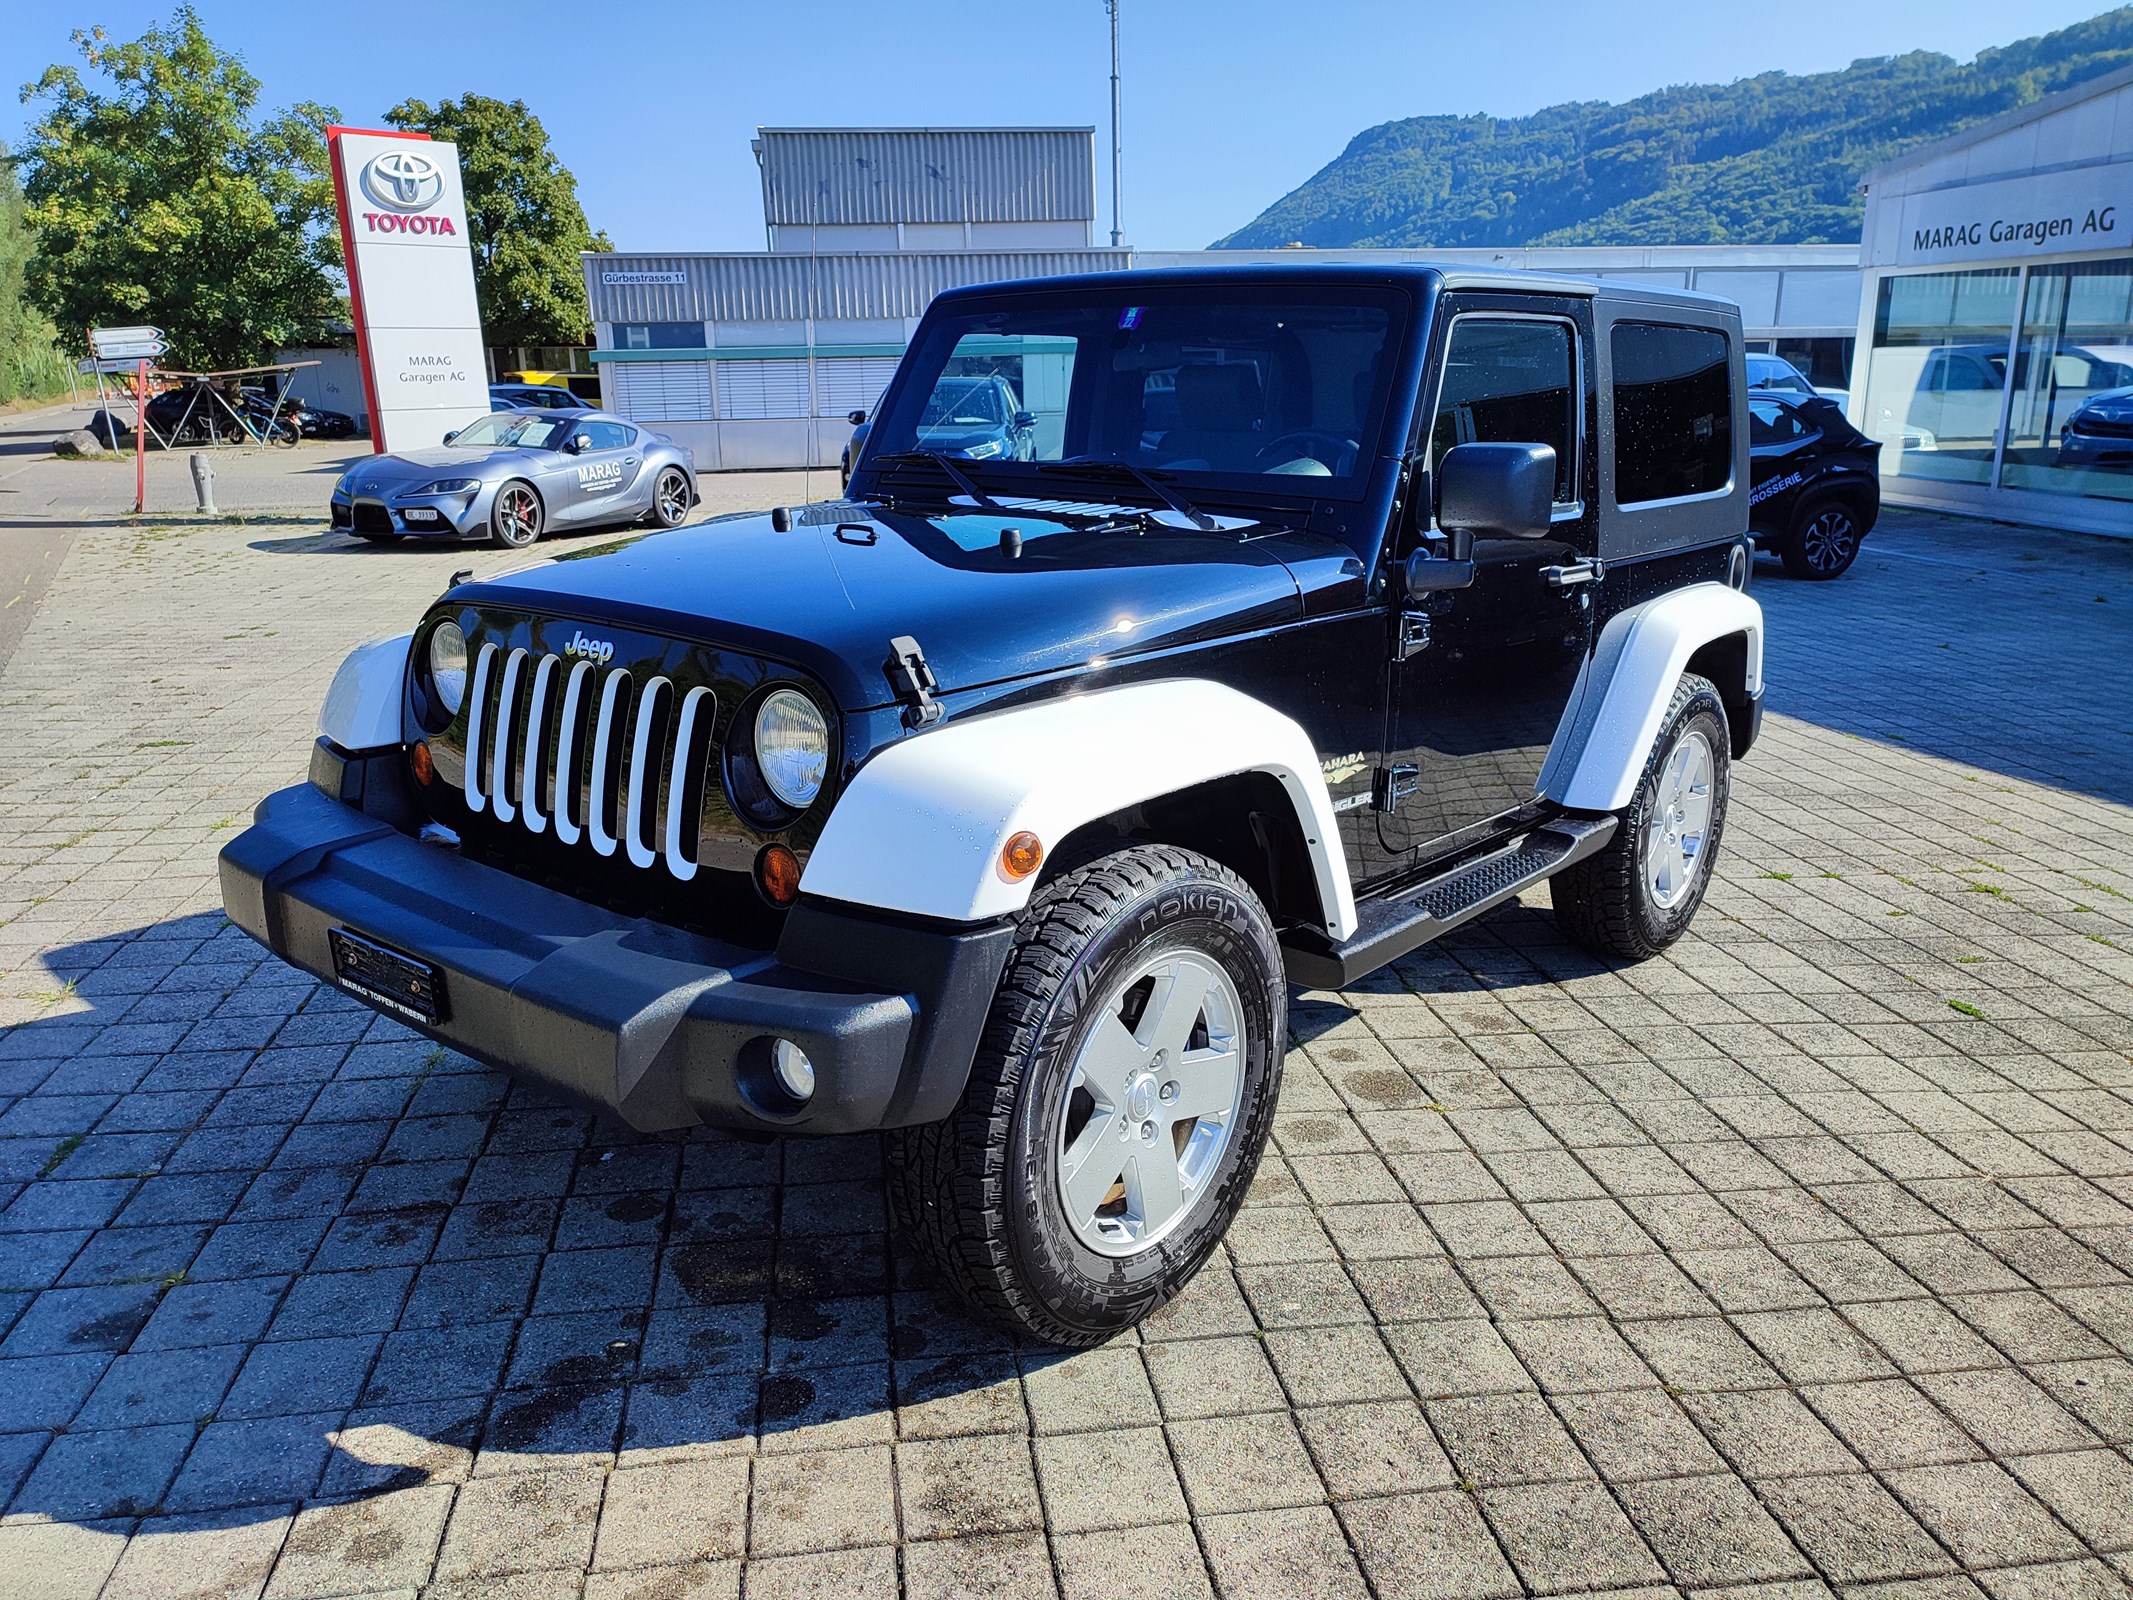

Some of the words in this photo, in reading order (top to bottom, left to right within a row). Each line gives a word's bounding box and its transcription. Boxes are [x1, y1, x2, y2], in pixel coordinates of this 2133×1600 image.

[362, 213, 457, 236] TOYOTA
[1913, 222, 1982, 251] MARAG
[1989, 219, 2073, 246] Garagen
[2081, 206, 2116, 234] AG
[604, 273, 672, 283] Gürbestrasse
[674, 273, 686, 282] 11
[408, 355, 452, 366] MARAG
[399, 372, 445, 385] Garagen
[449, 371, 466, 381] AG
[577, 461, 621, 483] MARAG
[564, 630, 614, 666] Jeep
[341, 978, 368, 996] MARAG
